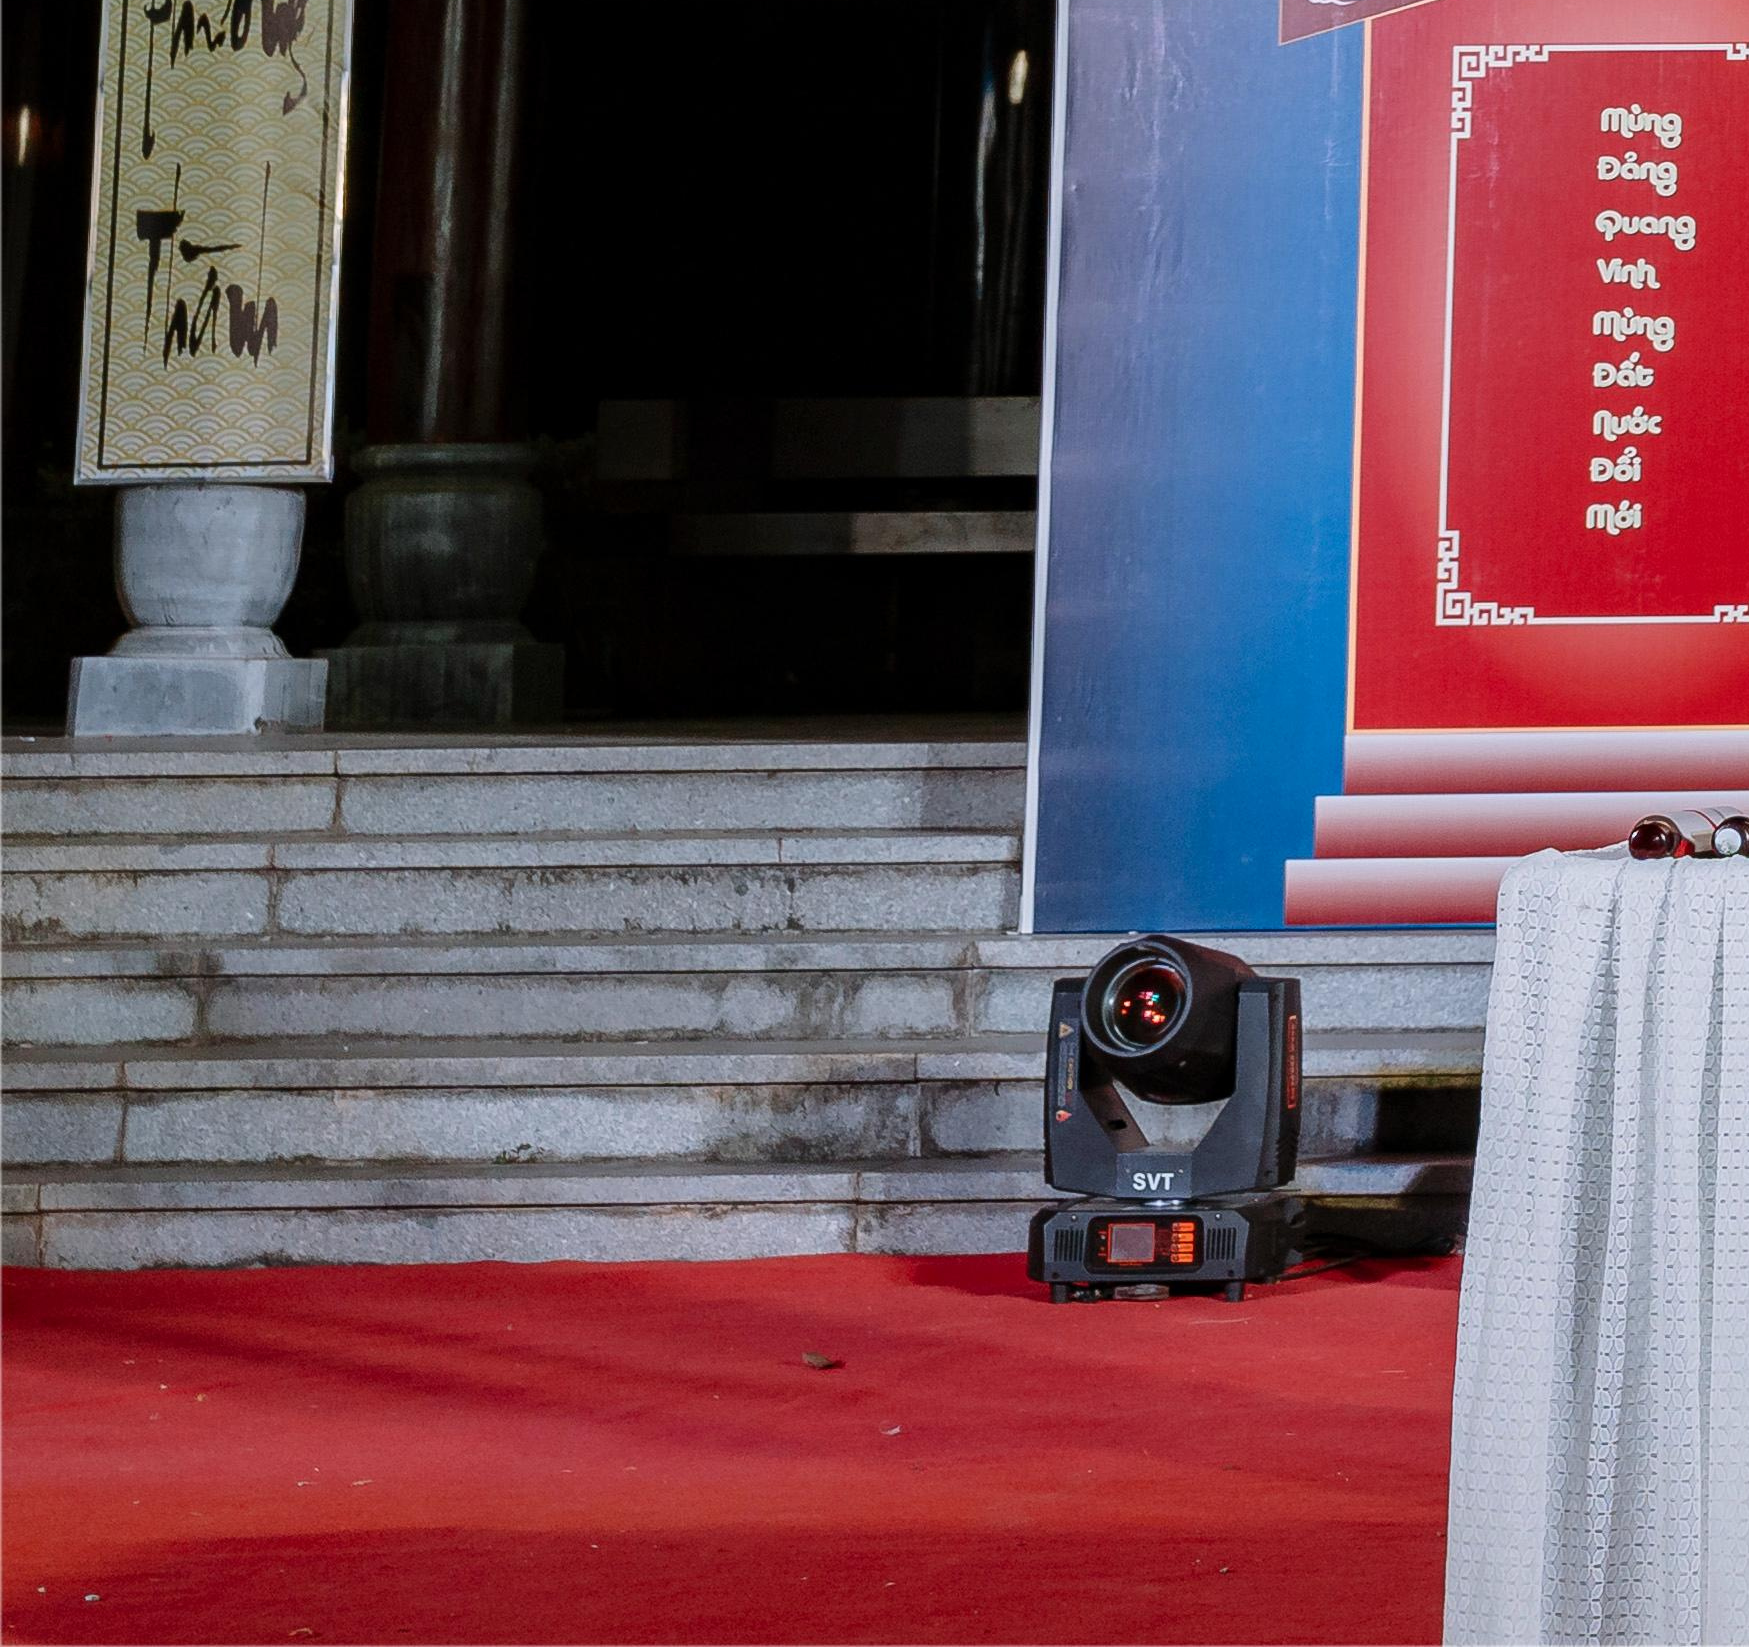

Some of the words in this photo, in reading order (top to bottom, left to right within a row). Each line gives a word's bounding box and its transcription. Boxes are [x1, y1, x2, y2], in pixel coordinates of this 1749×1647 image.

[1600, 104, 1682, 148] Mừng
[1597, 151, 1678, 196] Đảng
[1595, 209, 1696, 251] Quang
[1596, 258, 1661, 289] Vinh
[1593, 307, 1675, 352] Mừng
[1592, 351, 1654, 388] Đất
[1593, 406, 1662, 441] Nước
[1589, 446, 1642, 482] Đổi
[1586, 500, 1642, 535] Mới
[1132, 1172, 1174, 1191] SVT
